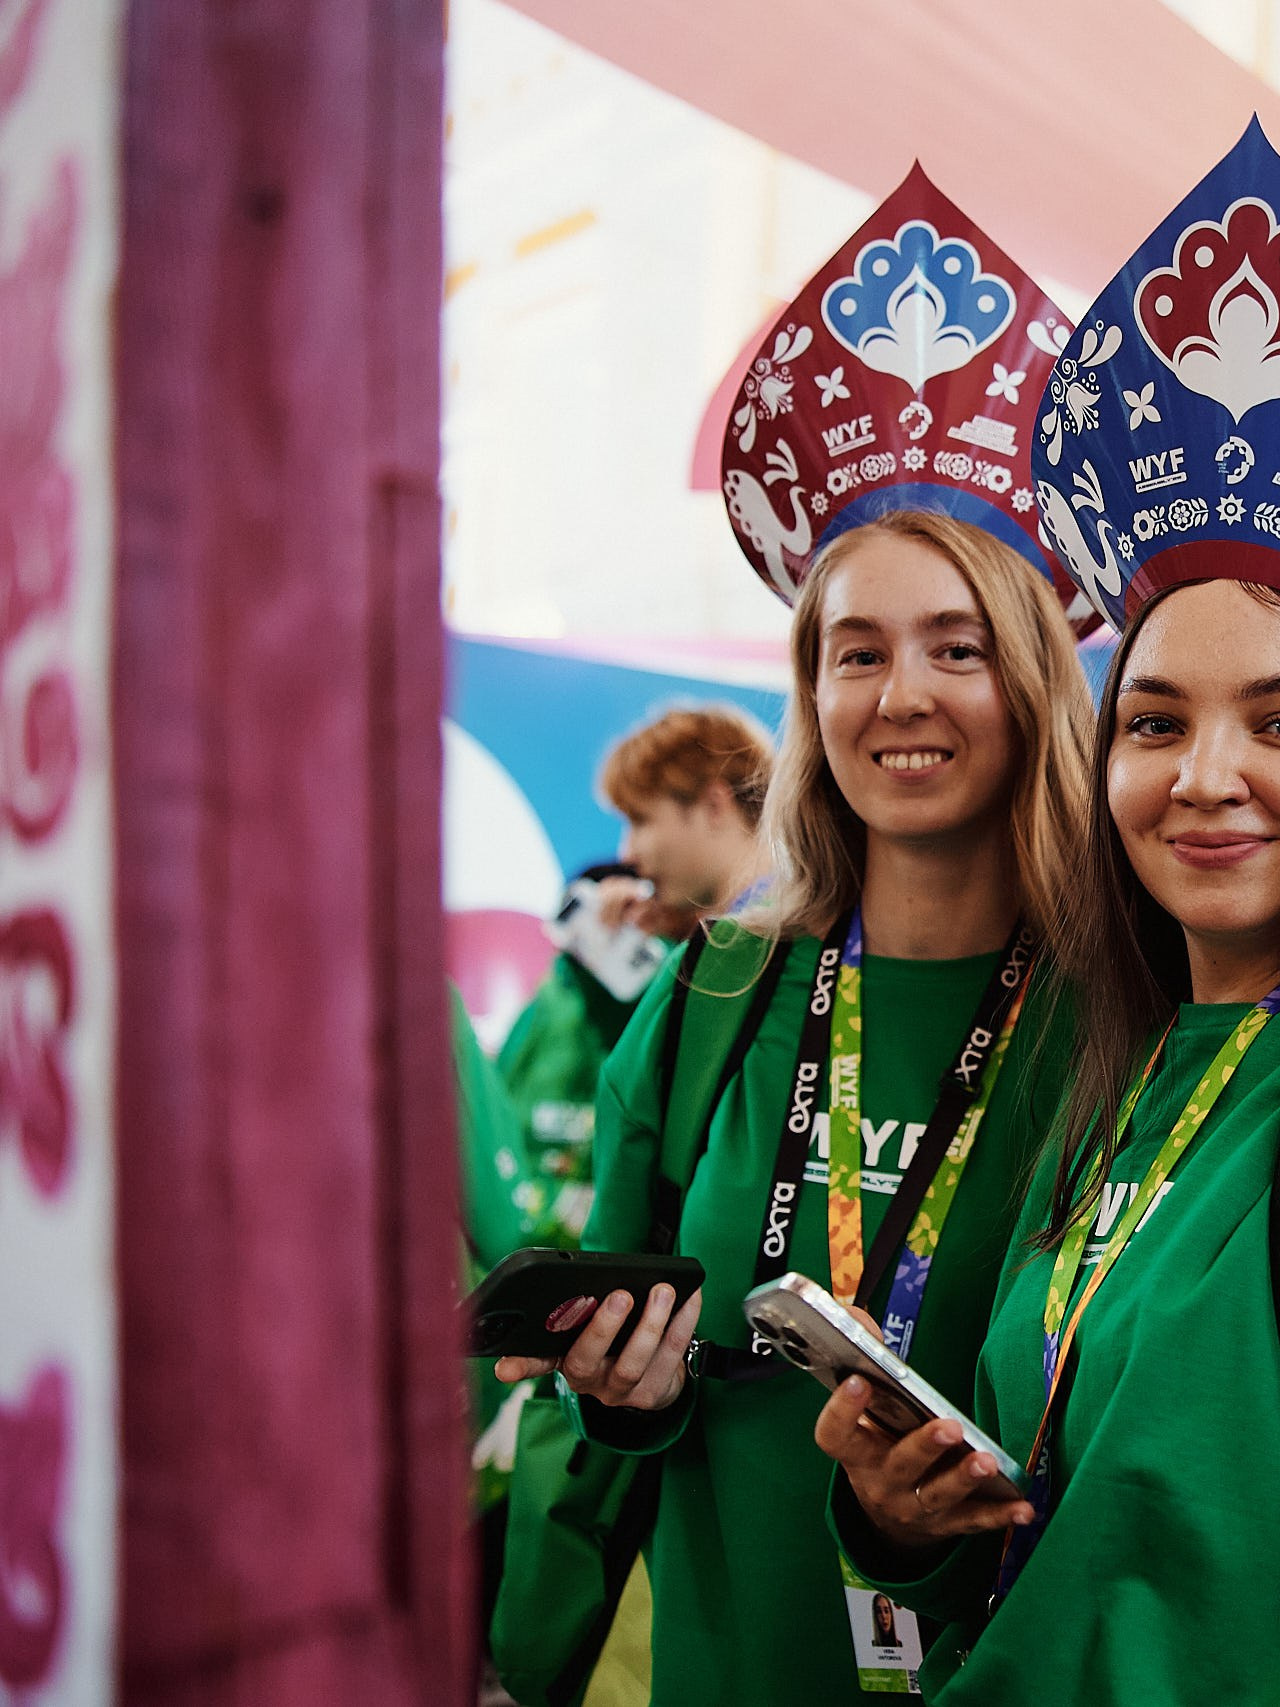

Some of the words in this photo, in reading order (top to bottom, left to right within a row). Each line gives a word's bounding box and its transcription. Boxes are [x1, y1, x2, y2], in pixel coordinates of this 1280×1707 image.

[821, 414, 872, 449] WYF
[1128, 447, 1184, 483] WYF
[839, 1055, 859, 1109] WYF
[884, 1312, 904, 1346] YF
